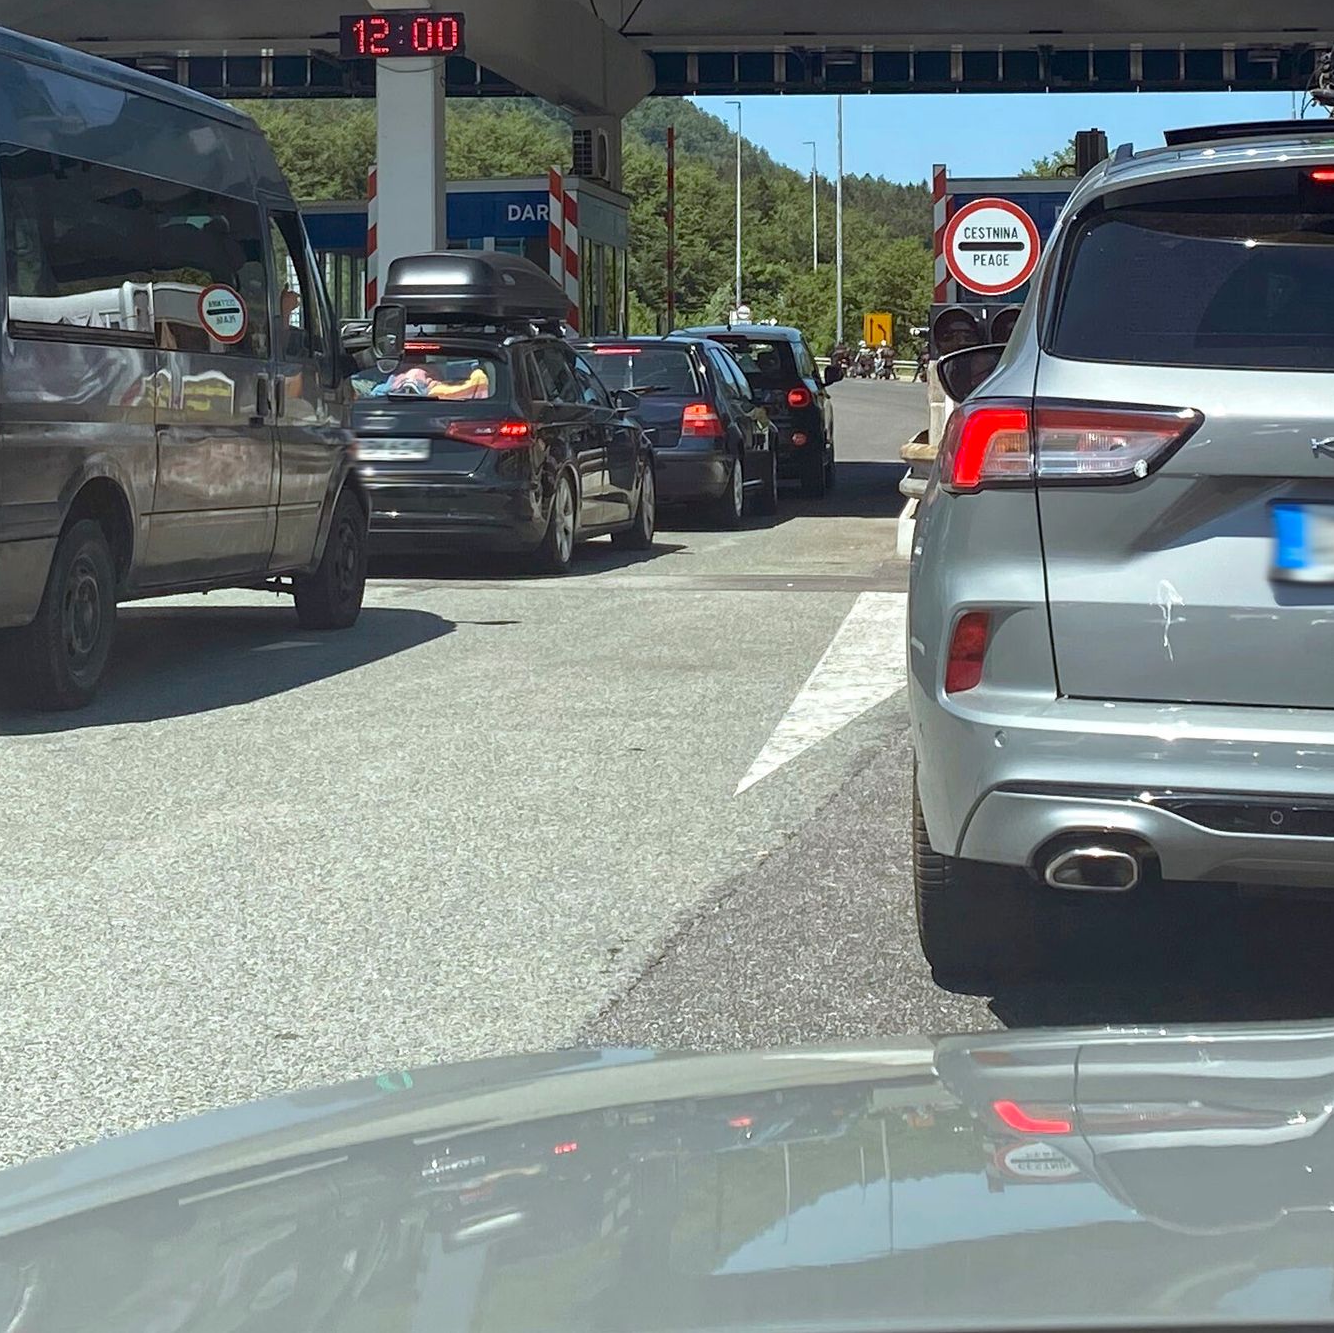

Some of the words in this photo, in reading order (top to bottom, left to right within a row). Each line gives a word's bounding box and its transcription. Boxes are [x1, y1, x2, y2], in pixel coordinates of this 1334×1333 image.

[353, 17, 458, 54] 12:00
[964, 227, 1019, 239] CESTNINA
[973, 254, 1010, 266] PEAGE
